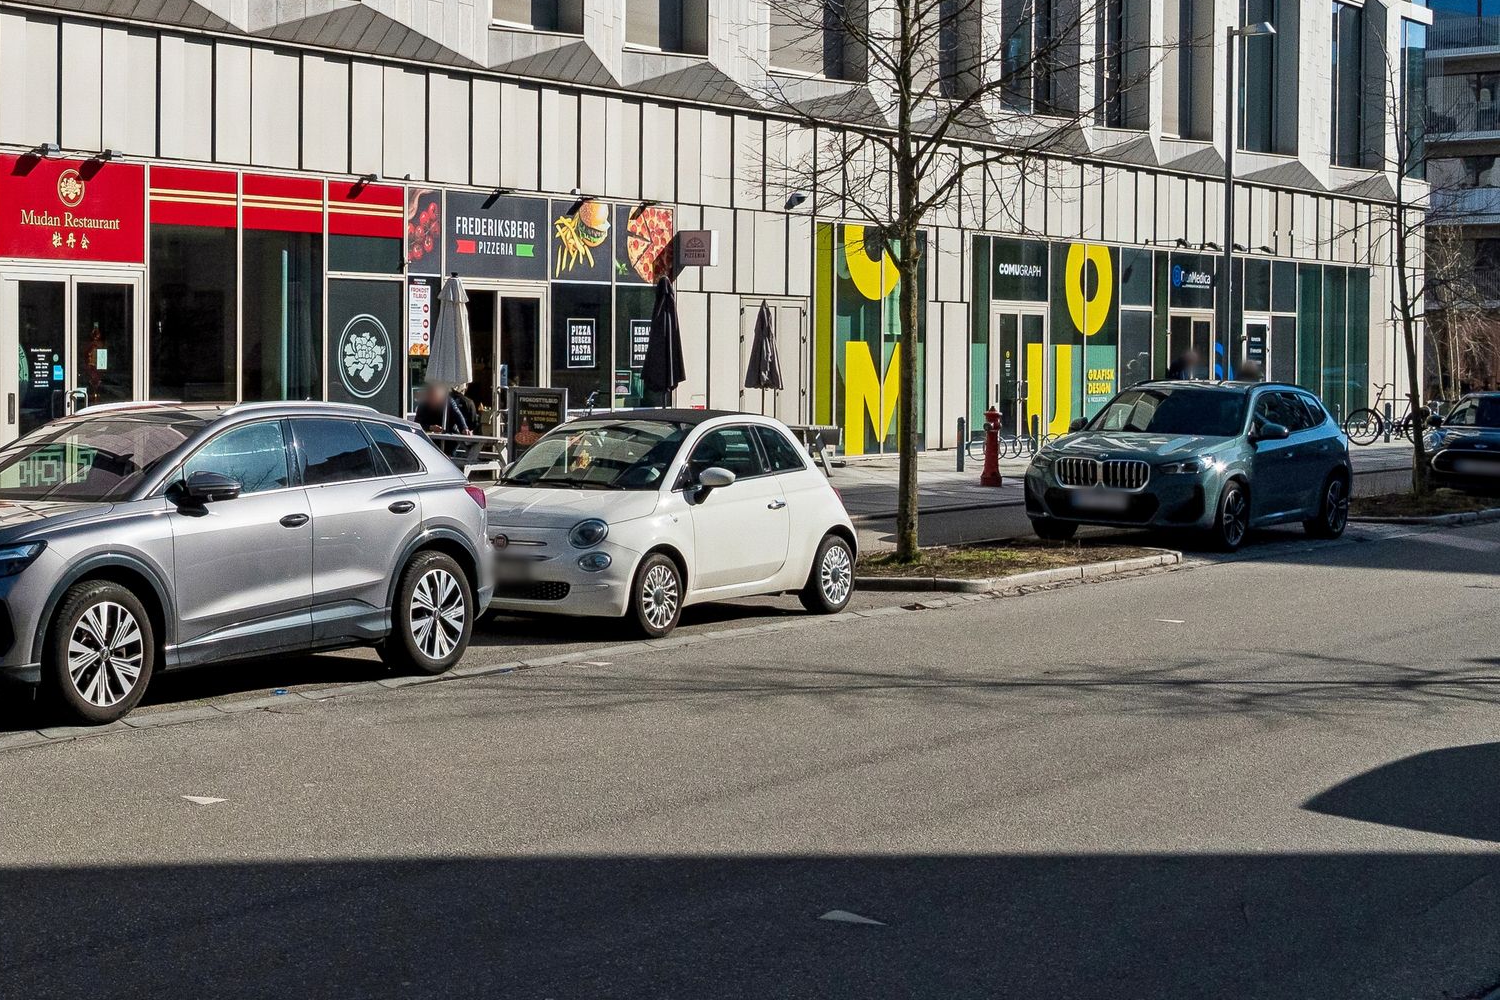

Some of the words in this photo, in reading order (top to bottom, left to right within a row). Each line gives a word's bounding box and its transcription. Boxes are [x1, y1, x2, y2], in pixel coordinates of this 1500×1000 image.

[20, 209, 61, 227] Mudan
[64, 212, 121, 230] Restaurant
[455, 216, 536, 239] FREDERIKSBERG
[478, 241, 514, 256] PIZZERIA
[998, 263, 1042, 278] COMUGRAPH
[572, 326, 591, 335] PIZZA
[572, 344, 591, 354] PASTA
[1087, 369, 1115, 381] GRAFISK
[1087, 382, 1111, 395] DESIGN
